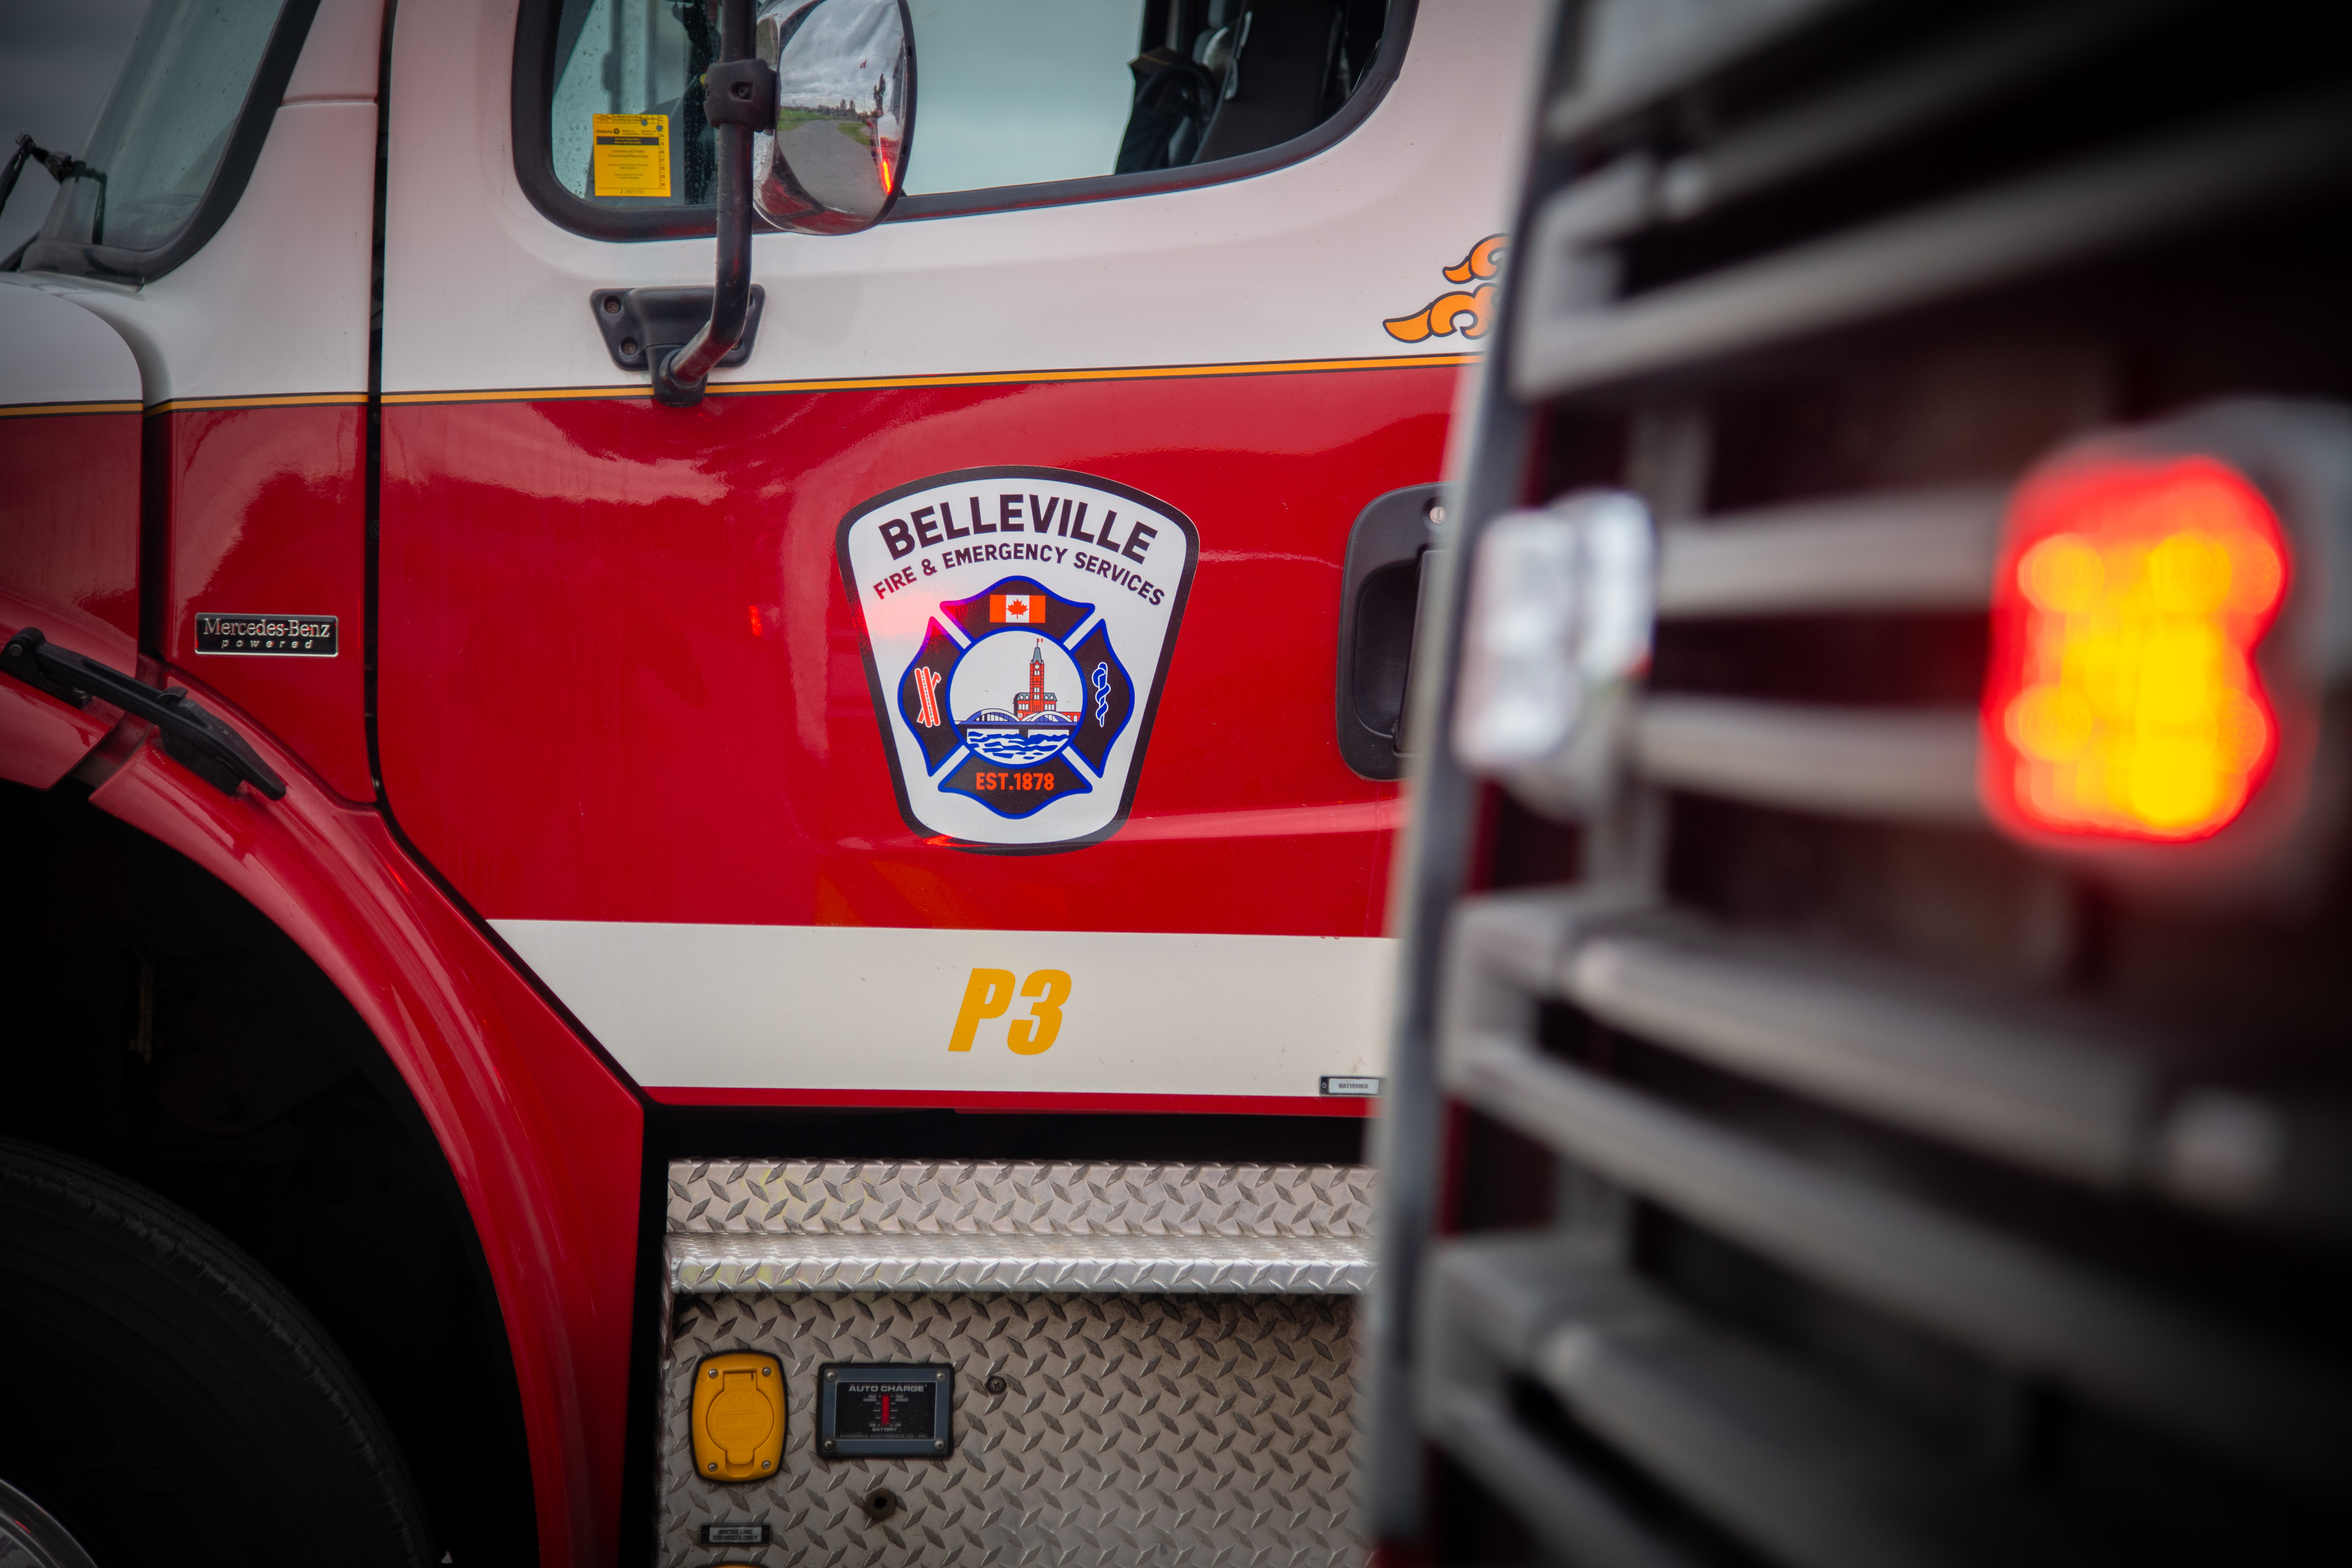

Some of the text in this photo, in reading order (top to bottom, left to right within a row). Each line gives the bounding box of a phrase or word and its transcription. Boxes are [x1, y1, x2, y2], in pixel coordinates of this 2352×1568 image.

[878, 494, 1158, 564] BELLEVILLE
[873, 543, 1165, 606] FIRE & EMERGENCY SERVICES
[203, 618, 330, 637] Mercedes-Benz
[221, 639, 313, 648] powered
[976, 772, 1054, 791] EST.1878
[948, 968, 1071, 1055] P3
